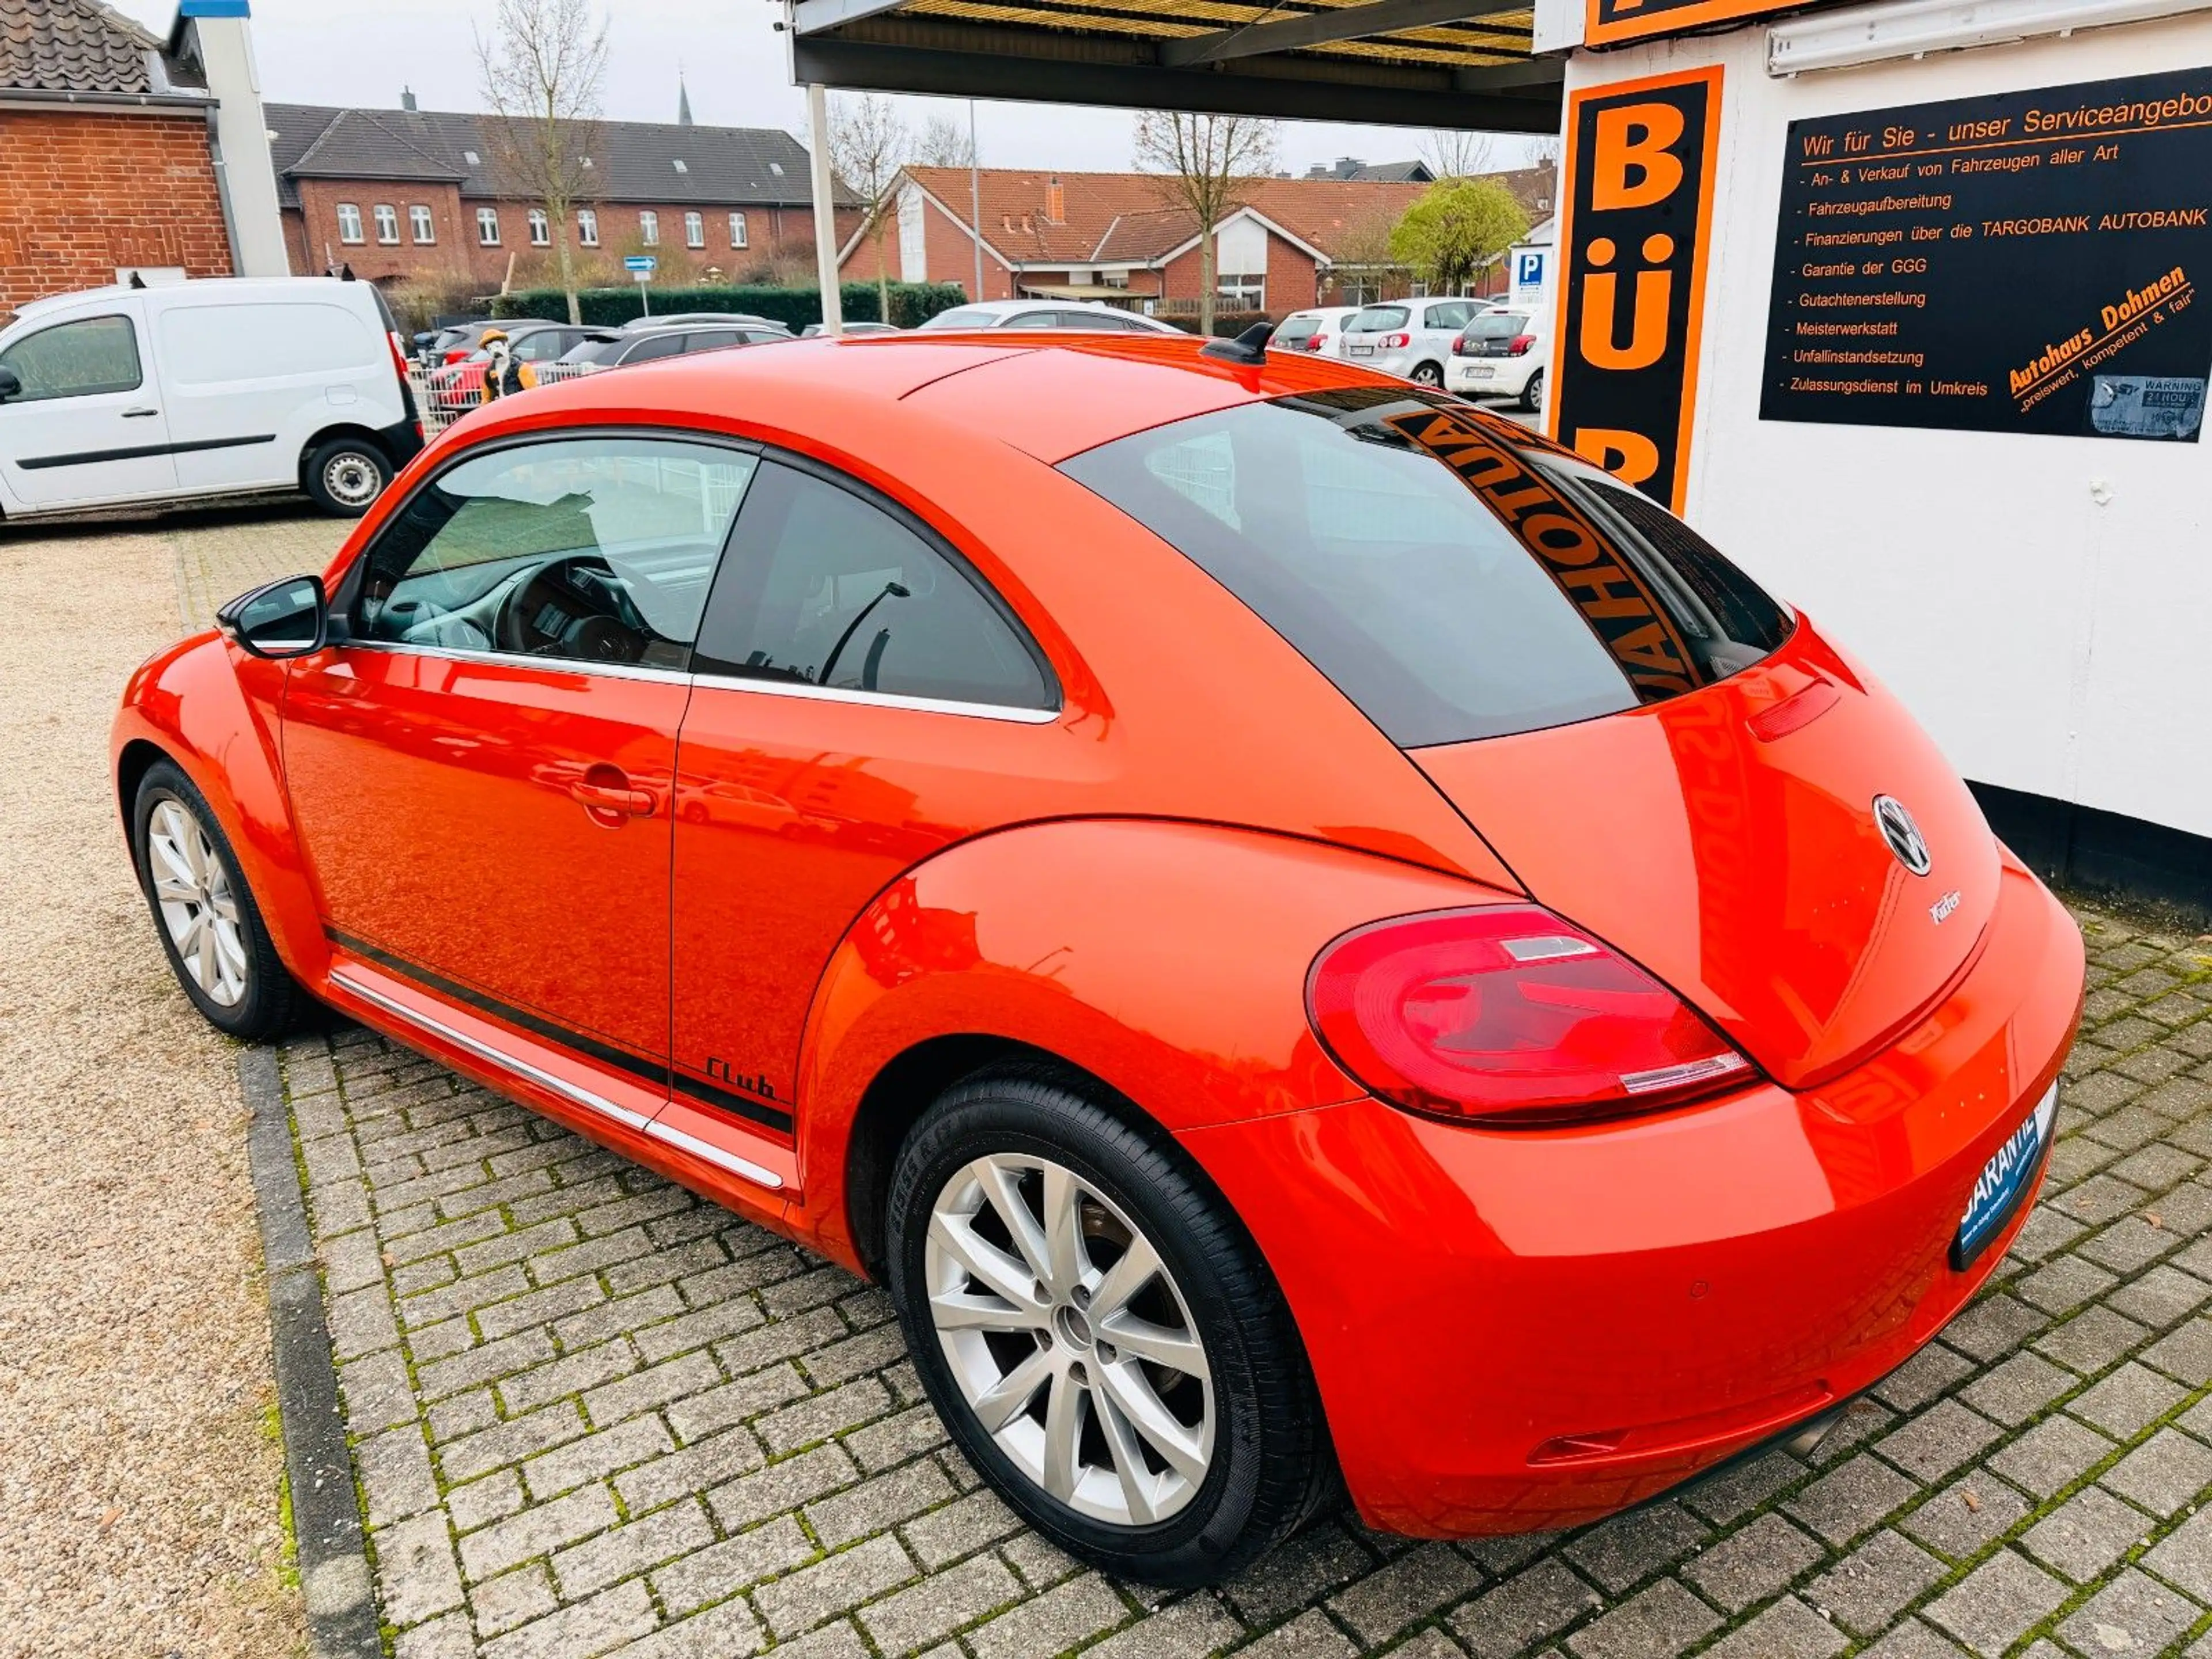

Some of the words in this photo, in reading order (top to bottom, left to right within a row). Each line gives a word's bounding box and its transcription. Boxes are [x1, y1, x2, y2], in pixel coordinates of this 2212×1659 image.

[1804, 135, 1834, 156] Wir
[1844, 131, 1871, 151] für
[1883, 126, 1915, 147] Sie
[1949, 118, 2011, 141] unser
[2024, 92, 2212, 132] Serviceangebo
[1811, 173, 1833, 186] An-
[1840, 170, 1850, 184] &
[1858, 164, 1911, 182] Verkauf
[1918, 164, 1942, 177] von
[1951, 155, 2040, 174] Fahrzeugen
[2050, 149, 2086, 165] aller
[2093, 145, 2119, 161] Art
[1809, 194, 1952, 217] Fahrzeugaufbereitung
[1805, 230, 1903, 247] Finanzierungen
[1911, 226, 1942, 240] über
[1950, 224, 1972, 238] die
[1981, 215, 2090, 236] TARGOBANK
[2099, 209, 2208, 230] AUTOBANK
[1524, 255, 1539, 281] P
[1802, 262, 1855, 277] Garantie
[1862, 261, 1884, 275] der
[1892, 258, 1927, 274] GGG
[1800, 291, 1926, 308] Gutachtenerstellung
[1796, 321, 1898, 336] Meisterwerkstatt
[2010, 327, 2093, 395] Autohaus
[2101, 266, 2186, 331] Dohmen
[2082, 321, 2148, 370] kompetent
[2153, 311, 2165, 324] &
[1794, 349, 1924, 367] Unfallinstandsetzung
[1790, 377, 1899, 395] Zulassungsdienst
[1906, 380, 1922, 393] im
[1930, 381, 1987, 396] Umkreis
[2145, 381, 2202, 391] WARNING
[2161, 393, 2195, 403] HOU
